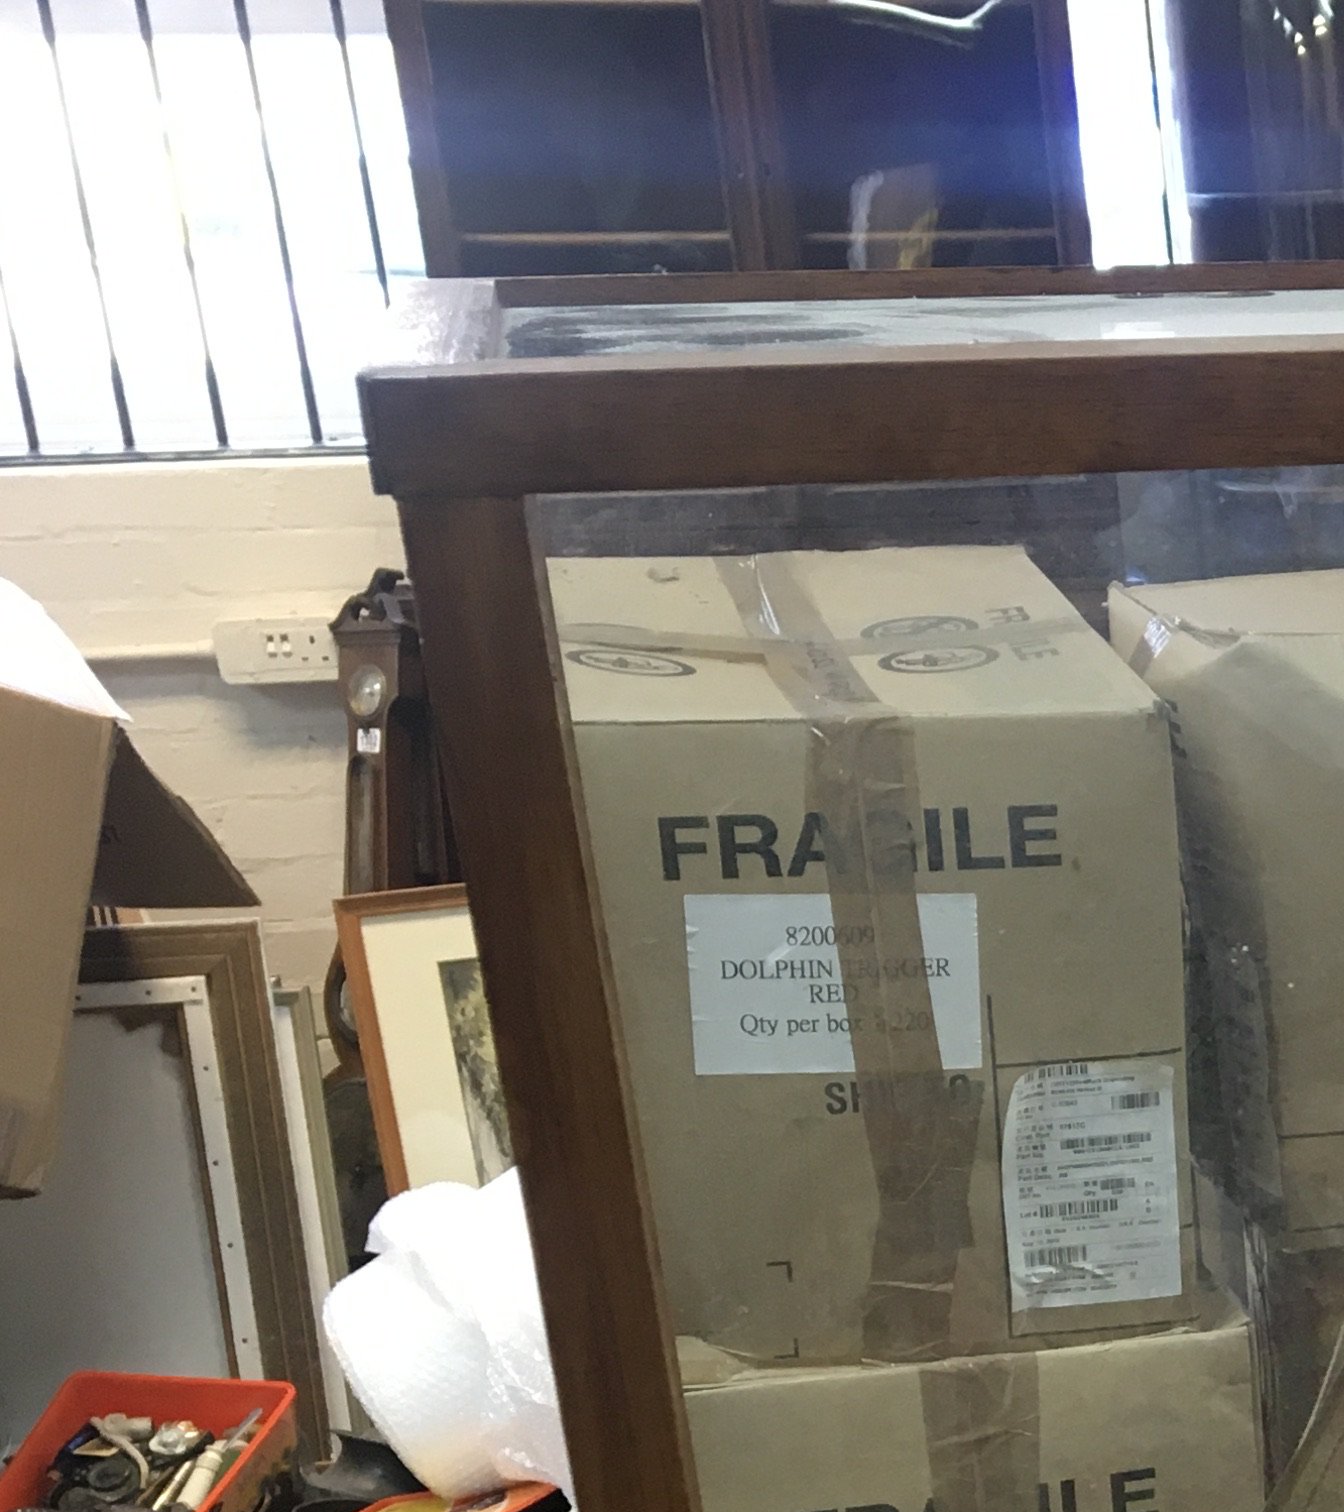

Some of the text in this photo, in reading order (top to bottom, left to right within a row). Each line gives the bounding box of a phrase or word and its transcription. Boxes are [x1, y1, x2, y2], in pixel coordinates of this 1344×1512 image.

[720, 959, 833, 980] DOLPHIN
[740, 1013, 778, 1036] Qty
[786, 1016, 820, 1036] per
